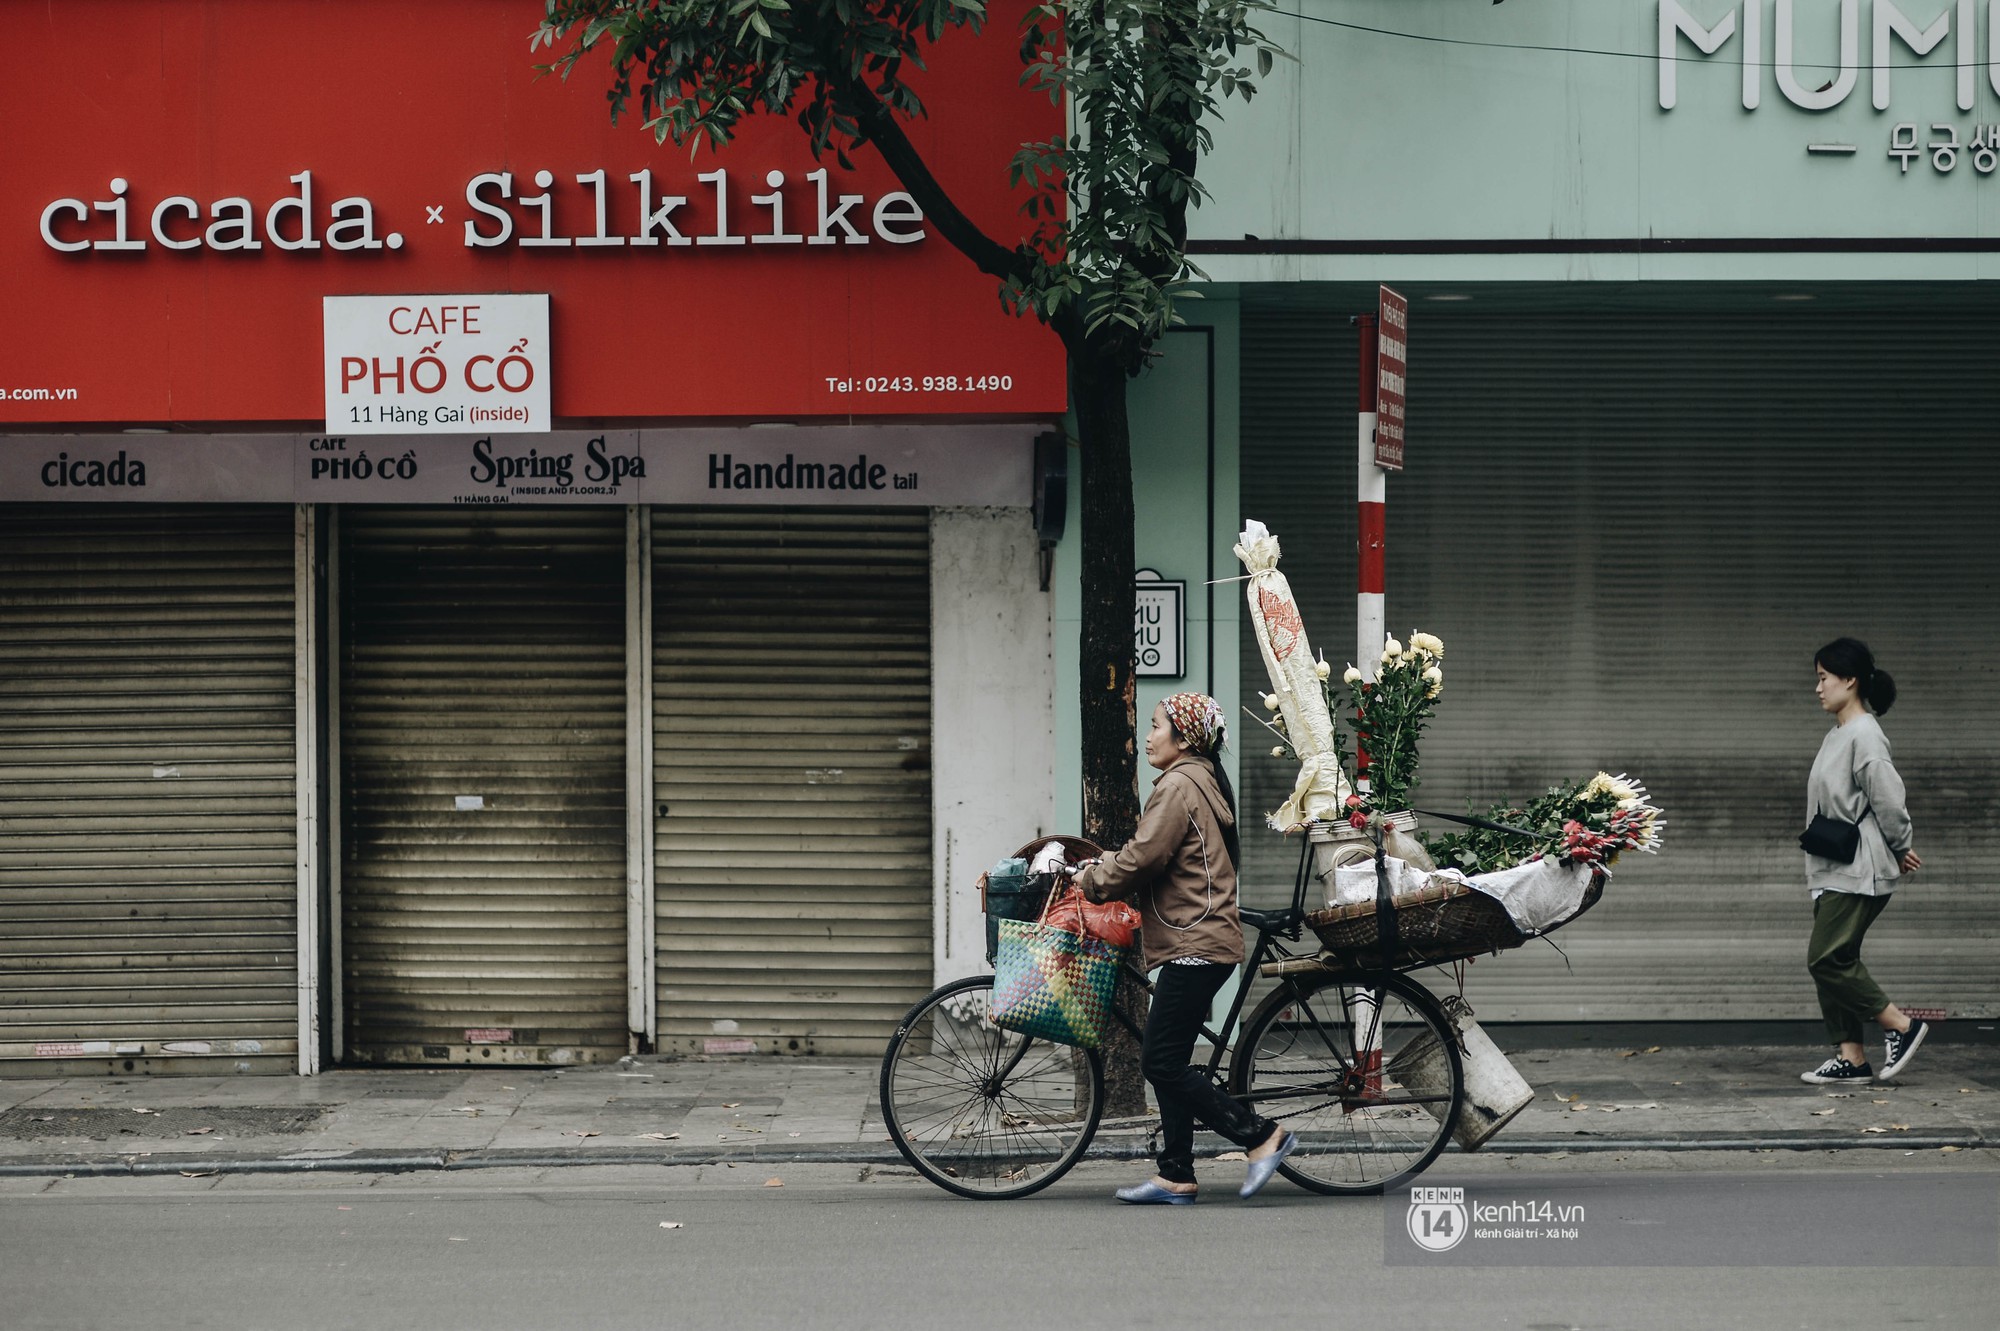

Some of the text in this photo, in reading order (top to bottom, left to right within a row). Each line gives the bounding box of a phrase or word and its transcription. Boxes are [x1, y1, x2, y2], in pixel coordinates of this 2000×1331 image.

[1658, 0, 2000, 110] MUM
[39, 170, 404, 252] cicada.
[464, 168, 926, 248] Silklike
[388, 305, 481, 335] CAFE
[341, 337, 534, 395] PHỐ CỔ
[350, 406, 529, 426] 11 Hàng Gai (inside)
[309, 438, 347, 451] CAFE
[470, 435, 647, 487] Spring Spa
[41, 450, 146, 487] cicada
[311, 450, 373, 480] PHỐ
[708, 453, 918, 490] Handmade tail
[464, 493, 491, 503] HÀNG
[492, 495, 509, 503] GAI
[549, 487, 568, 495] AND
